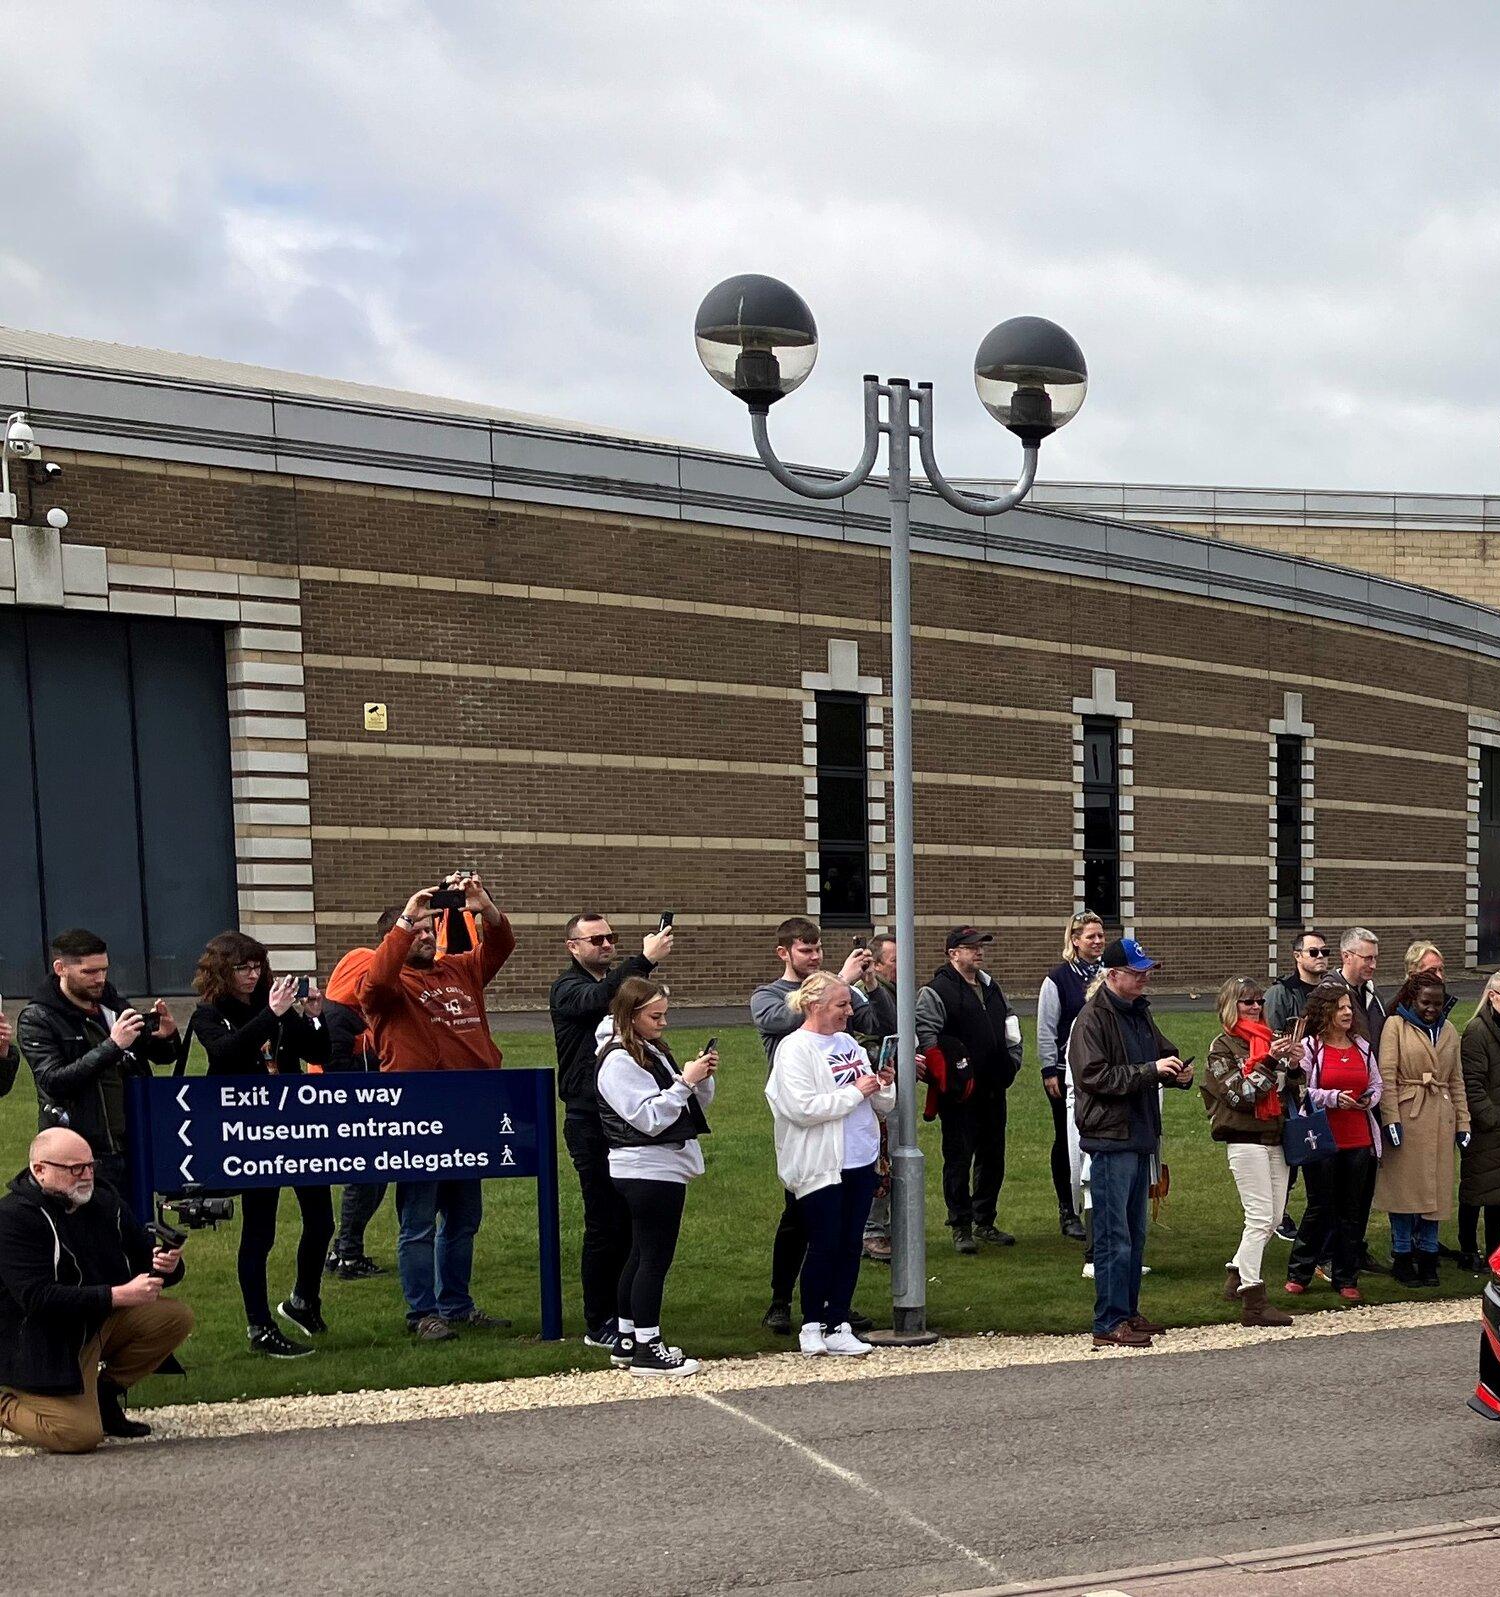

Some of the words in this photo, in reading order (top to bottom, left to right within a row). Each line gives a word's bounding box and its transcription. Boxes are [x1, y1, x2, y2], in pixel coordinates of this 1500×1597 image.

[220, 1086, 270, 1107] Exit
[297, 1085, 348, 1105] One
[355, 1087, 403, 1106] way
[222, 1121, 329, 1141] Museum
[337, 1117, 444, 1138] entrance
[222, 1155, 367, 1177] Conference
[374, 1149, 490, 1171] delegates
